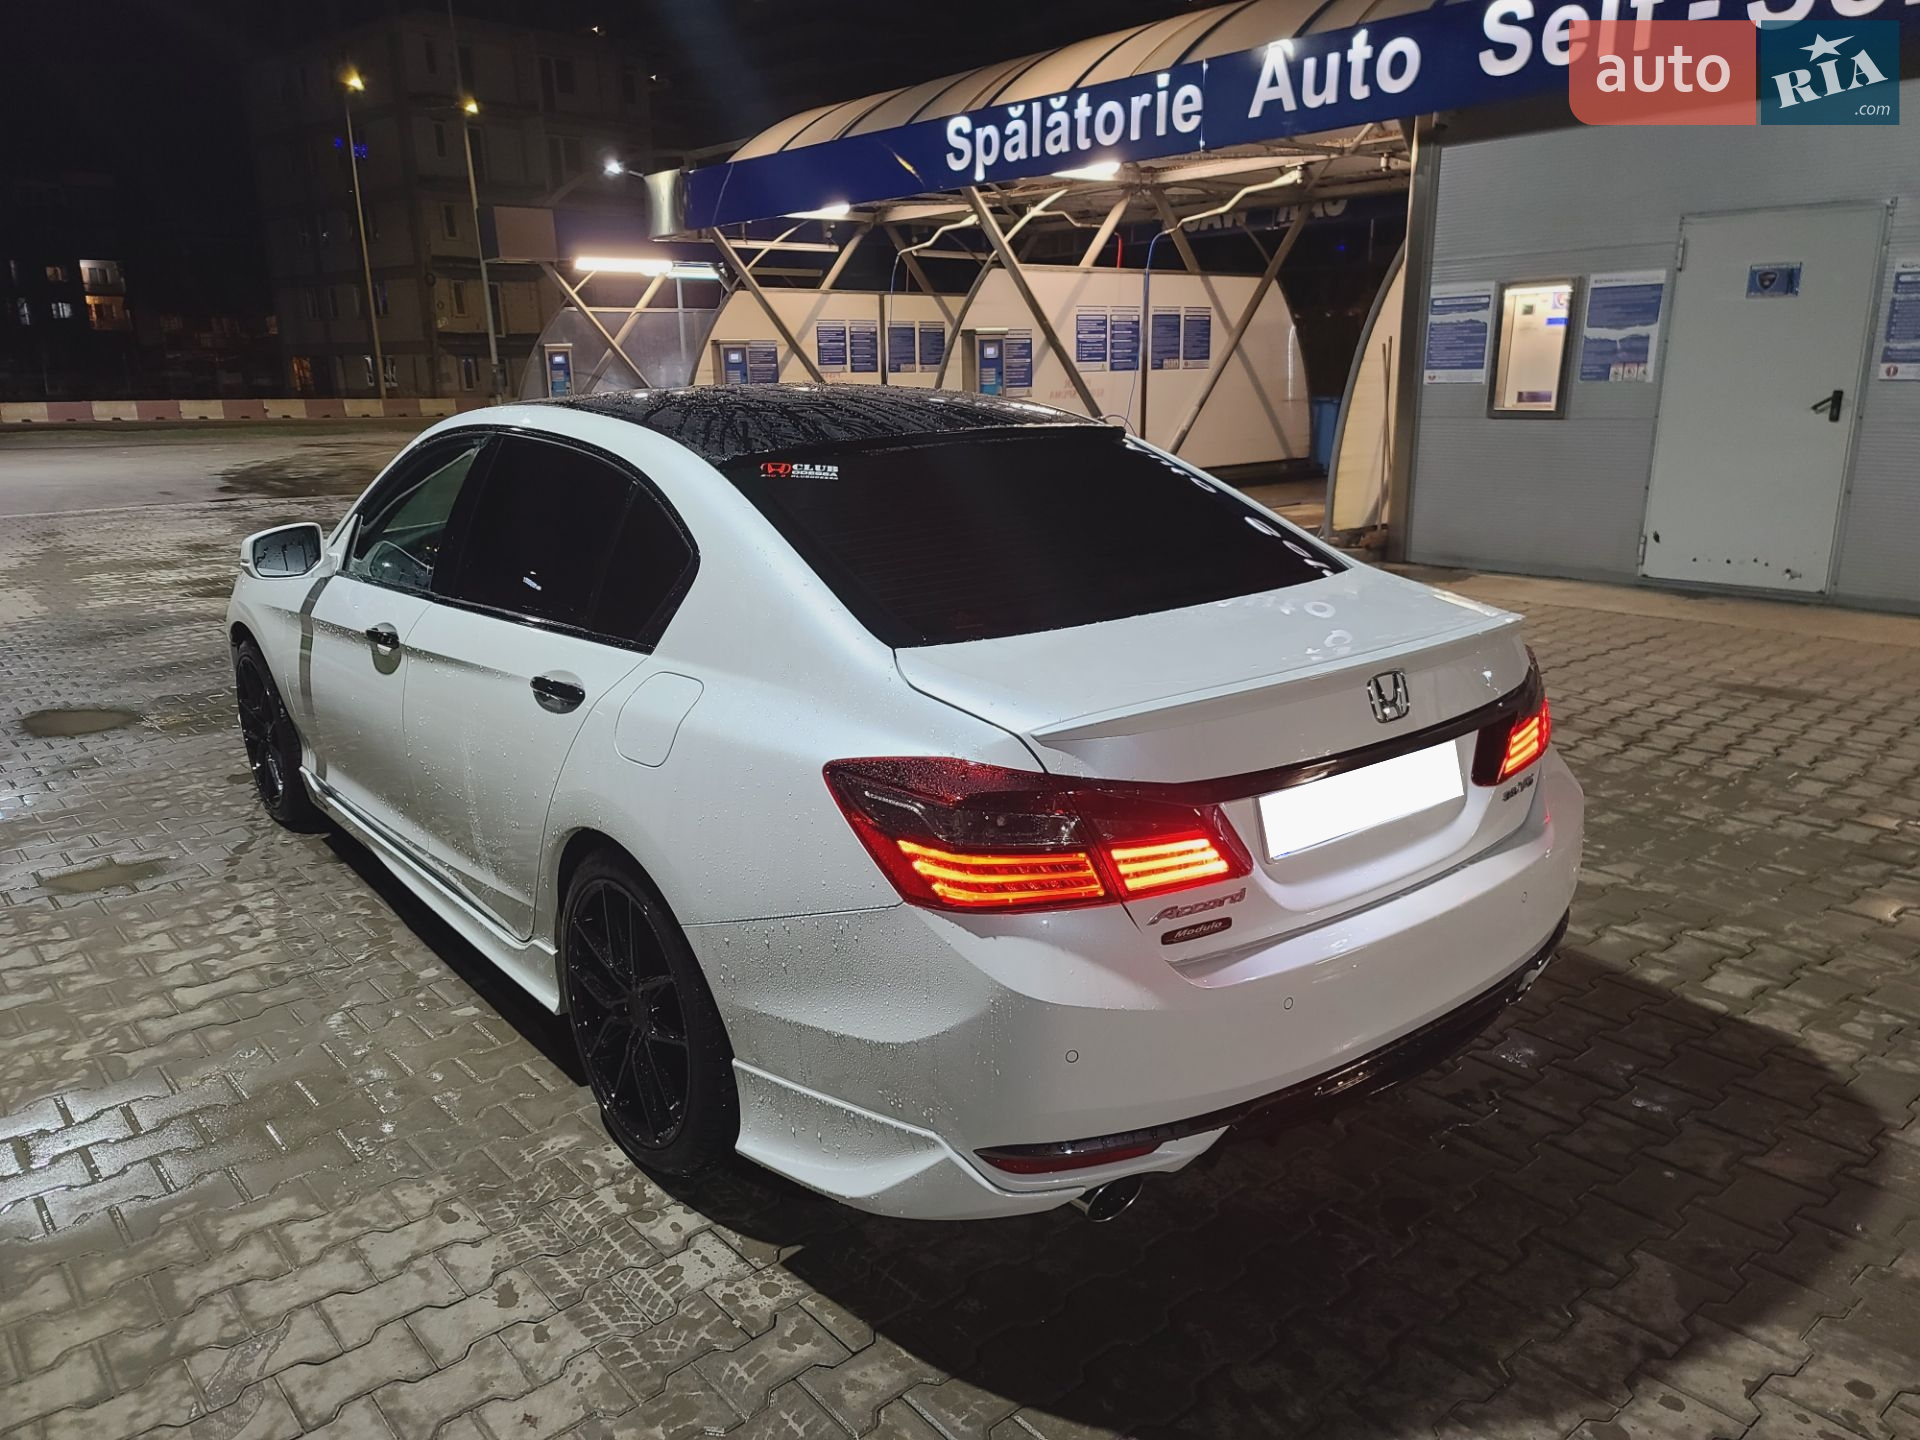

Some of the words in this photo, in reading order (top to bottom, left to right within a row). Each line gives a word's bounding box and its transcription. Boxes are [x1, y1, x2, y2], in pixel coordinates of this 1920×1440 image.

[946, 73, 1204, 183] Spălătorie
[1248, 28, 1422, 119] Auto
[792, 463, 839, 473] CLUB
[1147, 887, 1247, 926] Accord
[1174, 920, 1223, 939] Modulo
